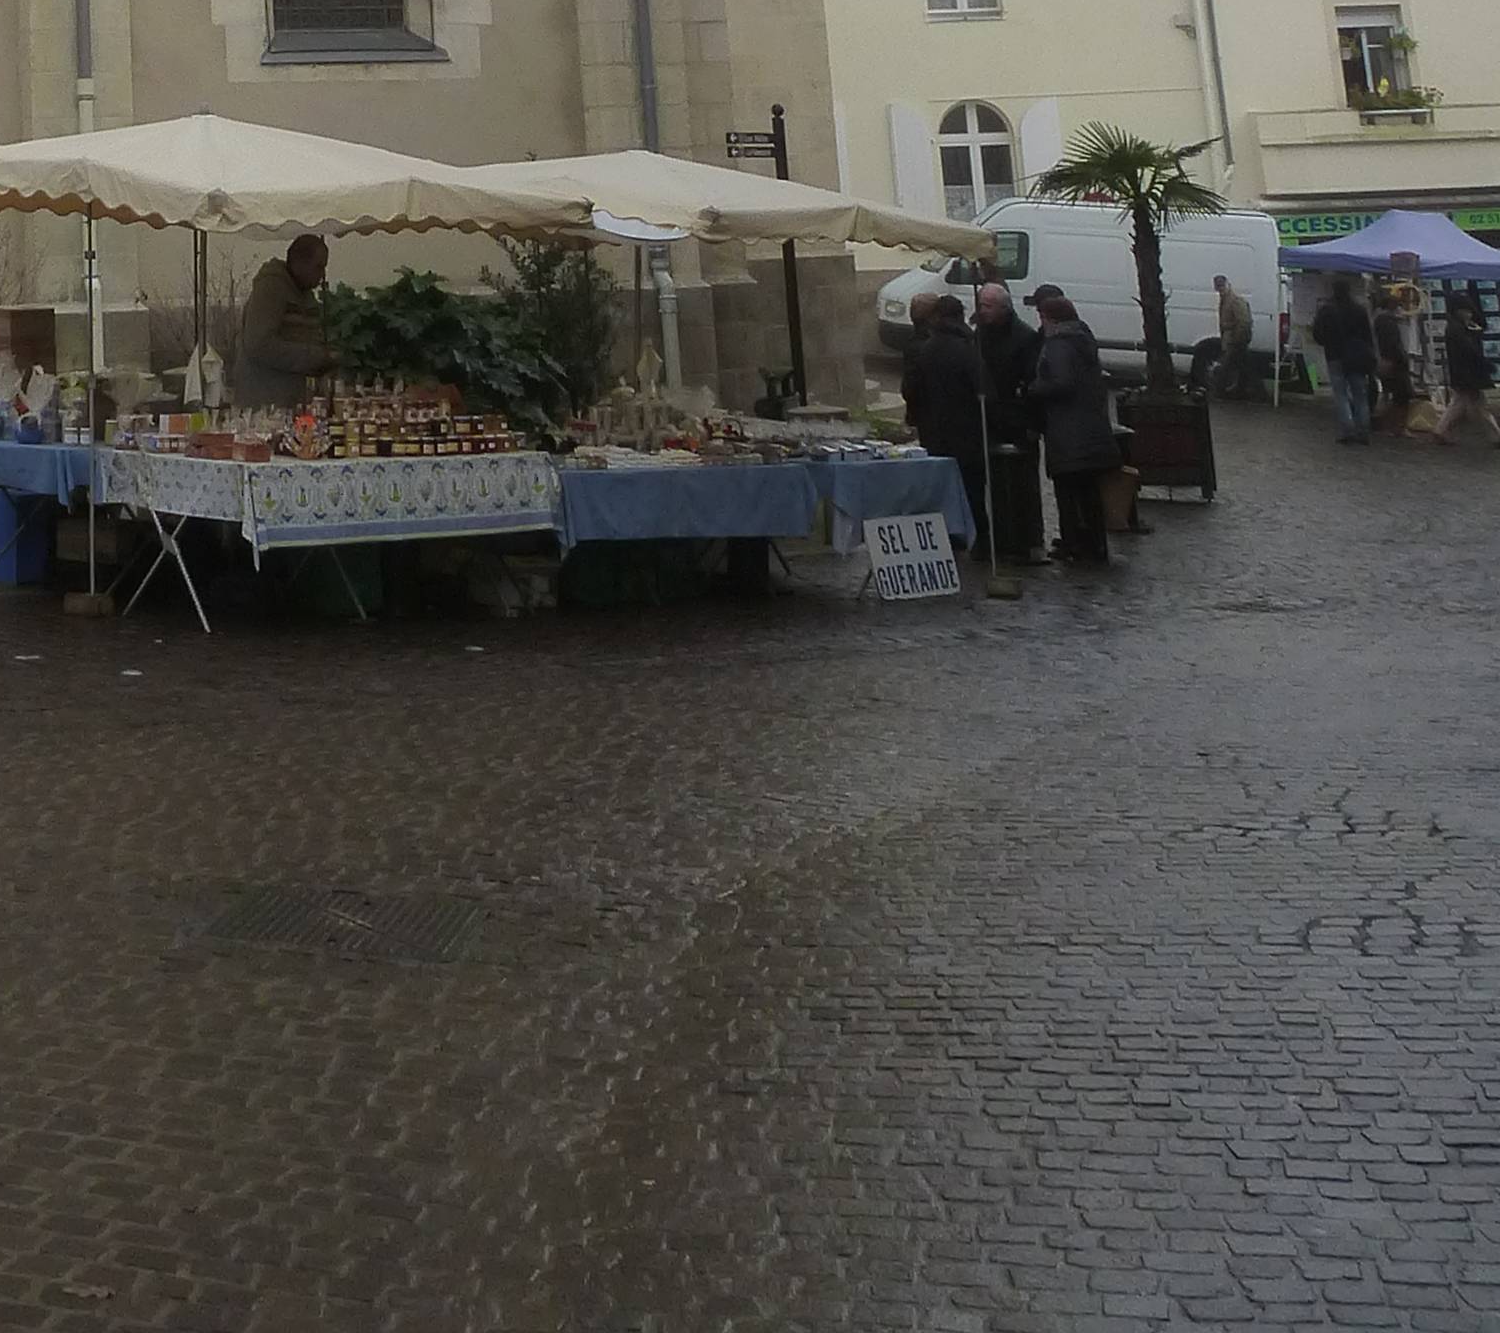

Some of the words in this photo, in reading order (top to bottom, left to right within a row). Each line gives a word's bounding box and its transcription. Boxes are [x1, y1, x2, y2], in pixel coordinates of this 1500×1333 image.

[878, 524, 910, 554] SEL
[914, 521, 938, 550] DE
[877, 559, 957, 596] GUERANDE
